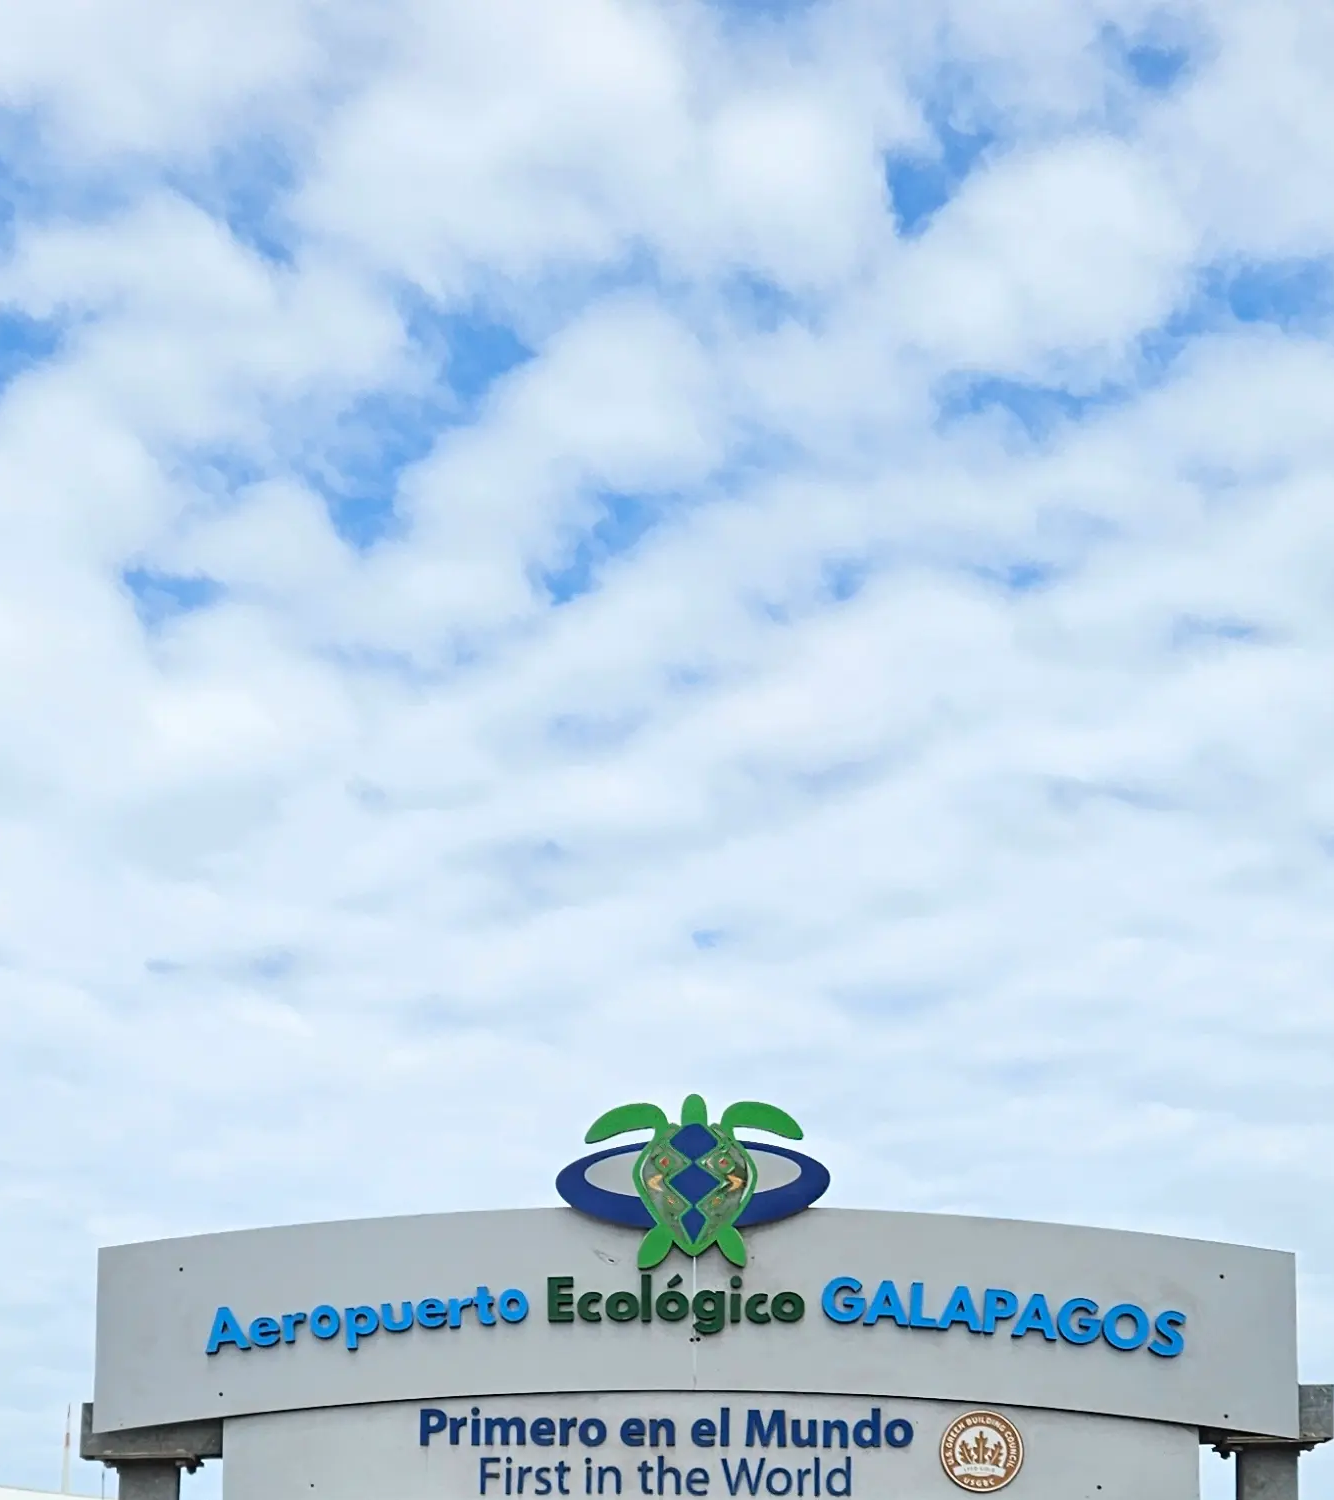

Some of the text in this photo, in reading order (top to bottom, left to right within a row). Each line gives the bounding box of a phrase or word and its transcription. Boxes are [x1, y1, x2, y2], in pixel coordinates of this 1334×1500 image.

[205, 1273, 1187, 1358] Aeropuerto Ecológico GALAPAGOS
[419, 1407, 914, 1449] Primero en el Mundo
[965, 1416, 1007, 1432] BUILDING
[1004, 1430, 1017, 1468] COUNCIL
[479, 1455, 853, 1497] First in the World
[963, 1477, 996, 1488] USGBC
